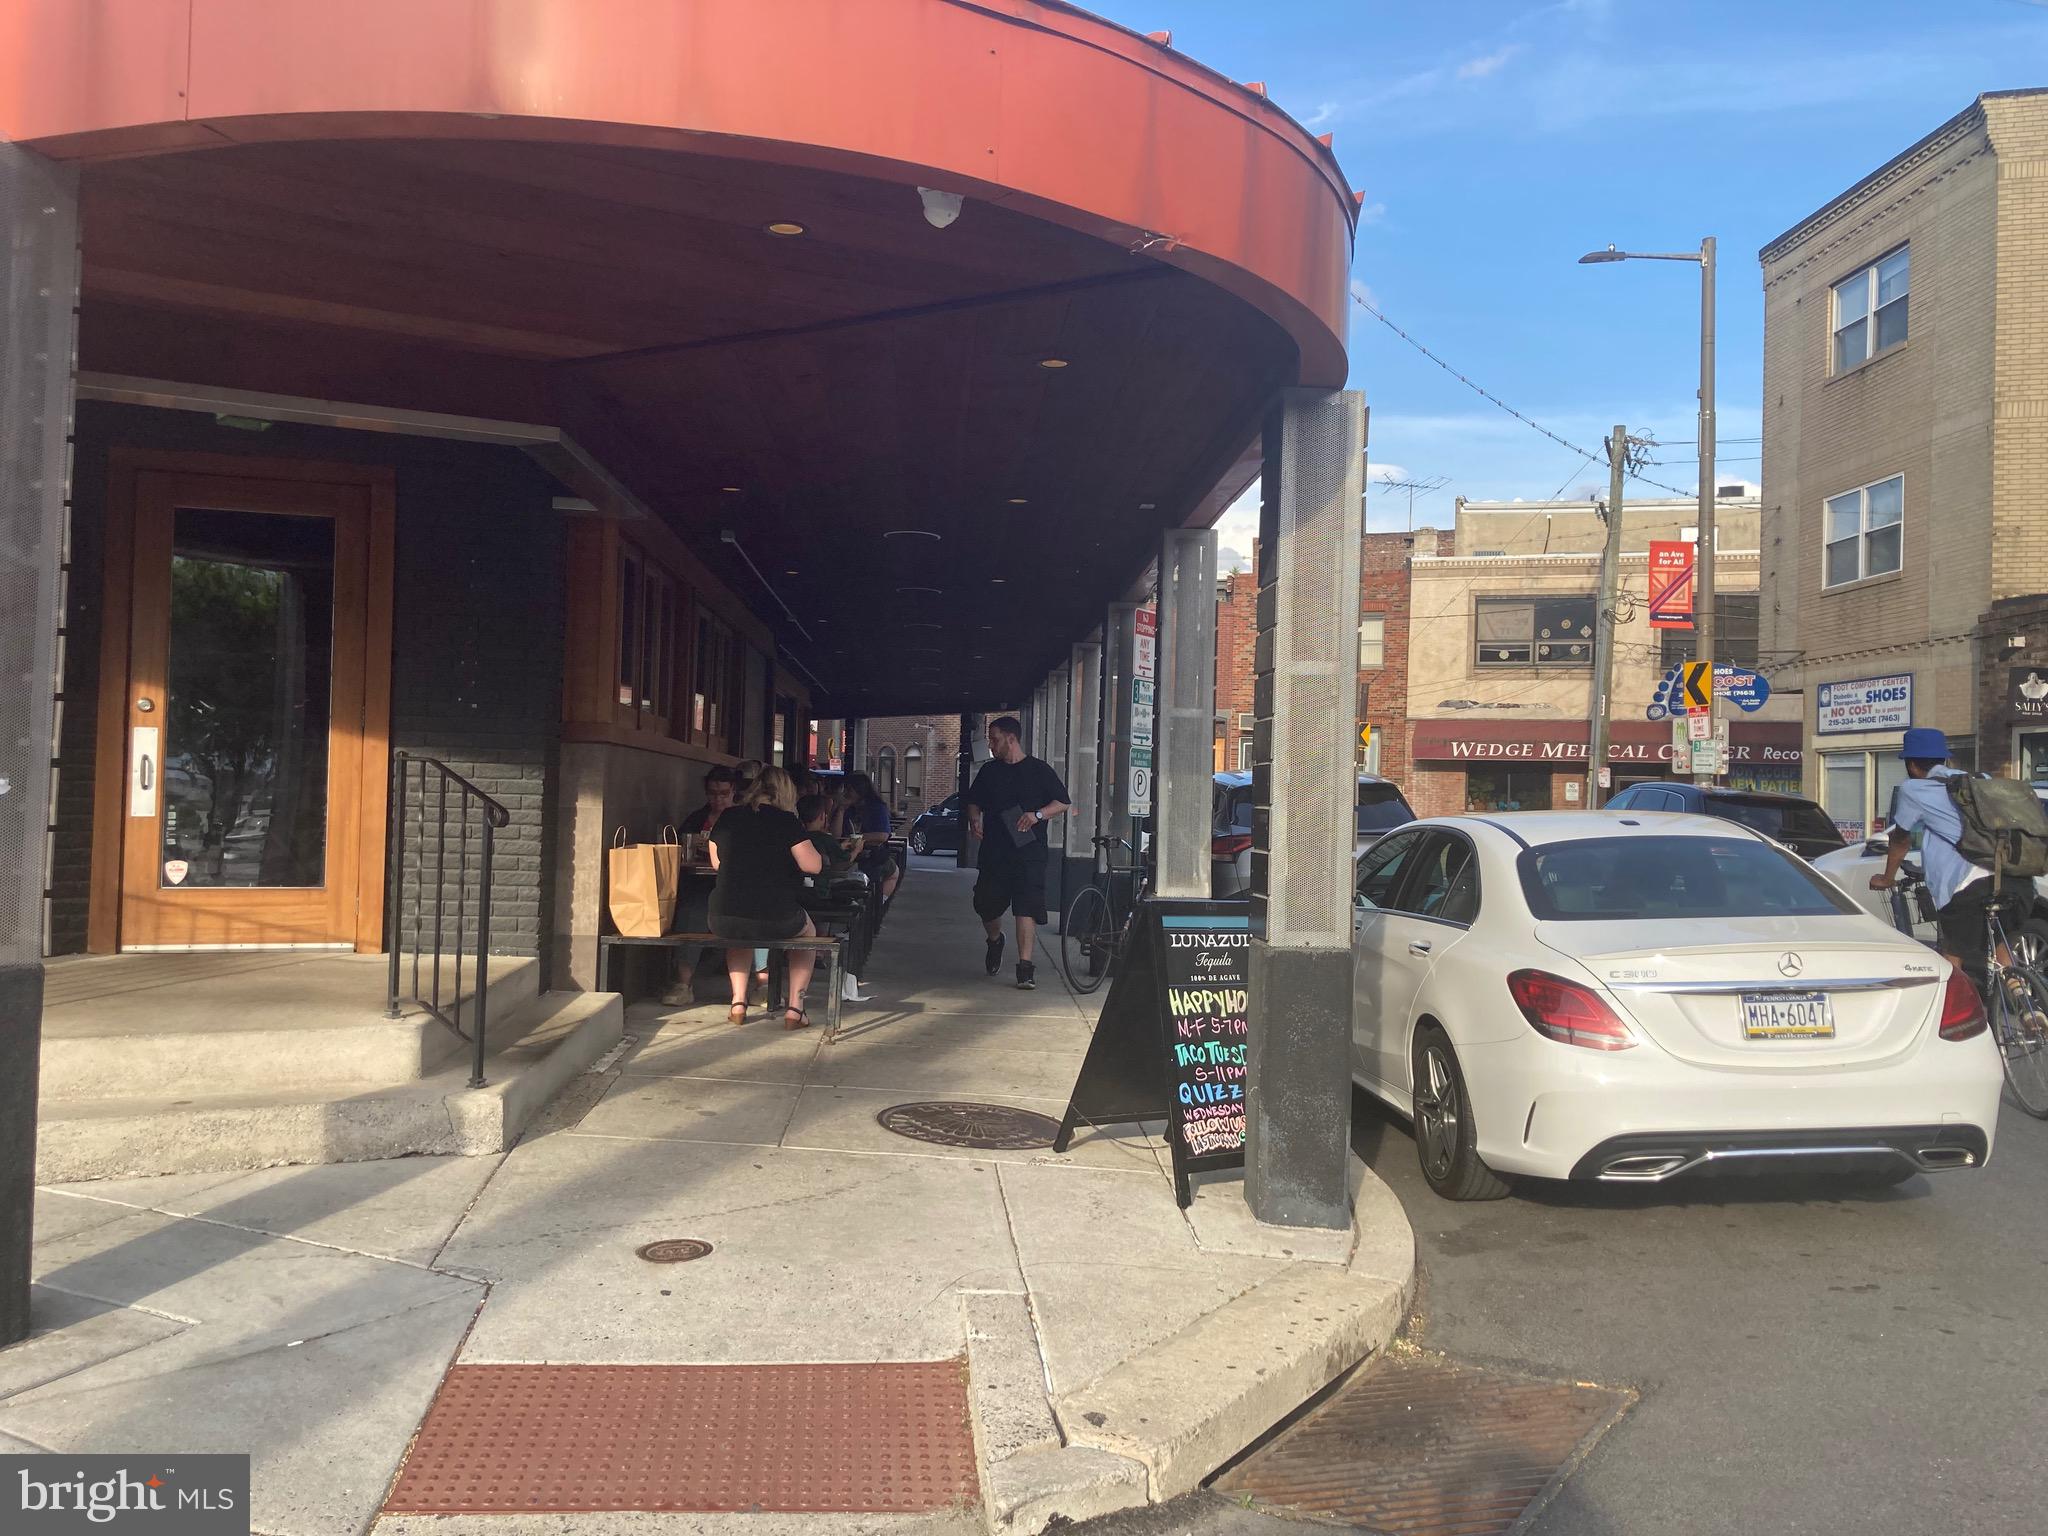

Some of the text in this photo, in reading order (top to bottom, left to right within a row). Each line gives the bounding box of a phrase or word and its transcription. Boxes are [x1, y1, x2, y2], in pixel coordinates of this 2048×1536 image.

[1833, 677, 1909, 692] FOOT COMFORT CENTER
[1865, 687, 1907, 703] SHOES
[1831, 708, 1845, 718] NO
[1849, 705, 1873, 715] COST
[1857, 716, 1877, 724] SHOE
[1450, 741, 1534, 757] WEDGE
[1540, 742, 1649, 759] MEDCAL
[1195, 952, 1233, 972] Tequila
[1168, 988, 1227, 1017] HAPPY
[1177, 1017, 1207, 1038] M-F
[1174, 1043, 1207, 1067] TACO
[1178, 1082, 1244, 1105] QUIZZ
[1183, 1103, 1245, 1120] WEDNESDAY
[1182, 1116, 1230, 1143] FOLLOW
[1190, 1132, 1242, 1155] INSTAGRAM
